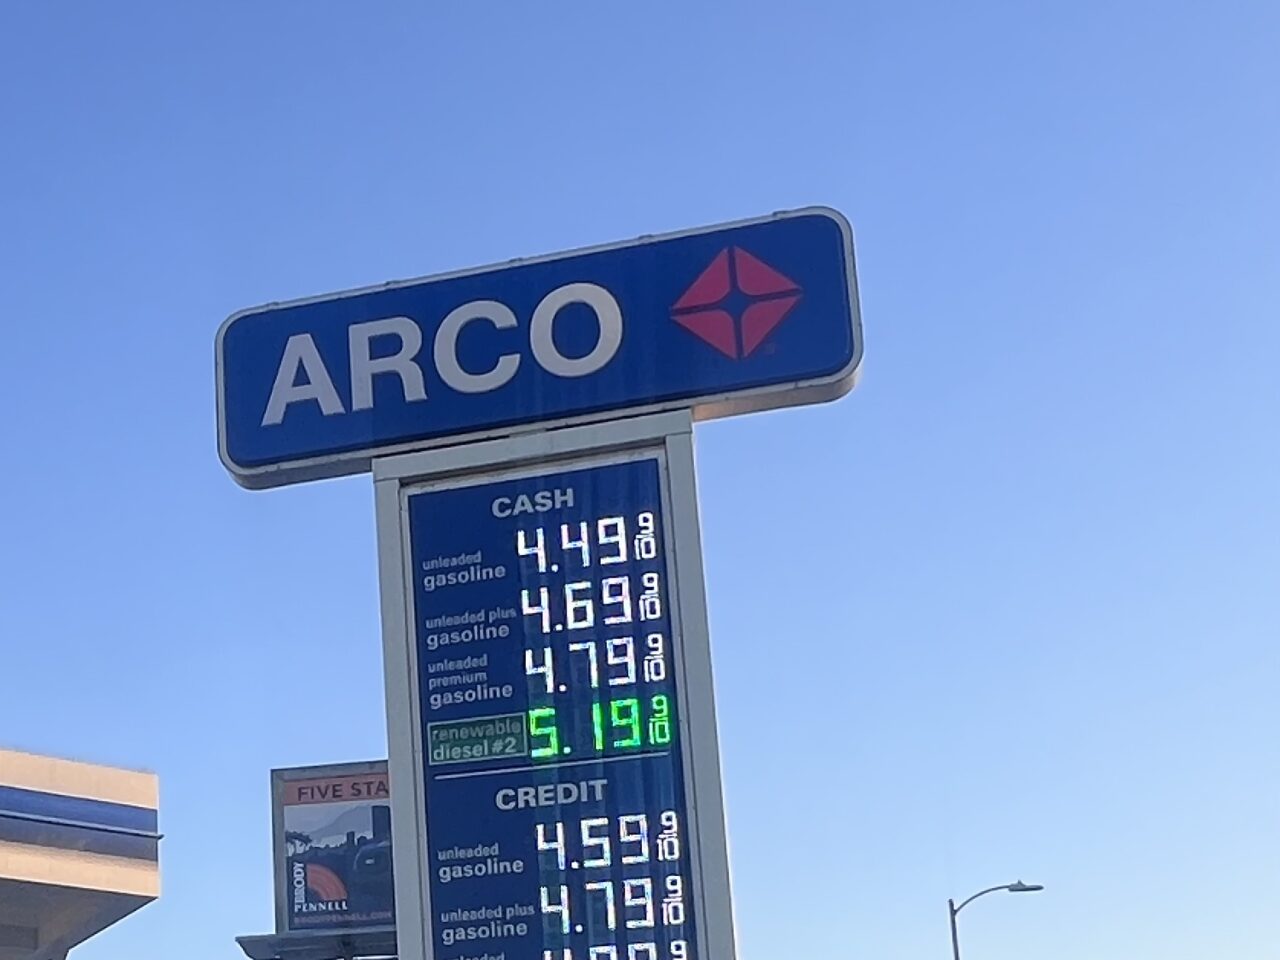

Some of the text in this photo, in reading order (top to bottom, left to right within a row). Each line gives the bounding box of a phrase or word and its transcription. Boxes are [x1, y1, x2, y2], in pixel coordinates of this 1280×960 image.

[261, 282, 623, 427] ARCO
[491, 488, 574, 518] CASH
[517, 516, 628, 573] 4.49
[422, 550, 482, 570] unleaded
[423, 564, 506, 591] gasoline
[425, 606, 517, 629] unleaded plus
[521, 576, 632, 633] 4.69
[426, 623, 510, 650] gasoline
[427, 654, 488, 674] unleaded
[525, 636, 636, 693] 4.79
[428, 670, 488, 690] premium
[429, 683, 513, 709] gasoline
[431, 718, 520, 742] renewable
[529, 697, 641, 758] 5.19
[433, 738, 489, 761] diesel
[297, 783, 343, 801] FIVE
[495, 779, 608, 811] CREDIT
[437, 843, 499, 861] unleaded
[536, 813, 650, 871] 4.59
[438, 859, 524, 883] gasoline
[440, 903, 536, 923] unleaded plus
[539, 877, 655, 934] 4.79
[442, 921, 528, 945] gasoline
